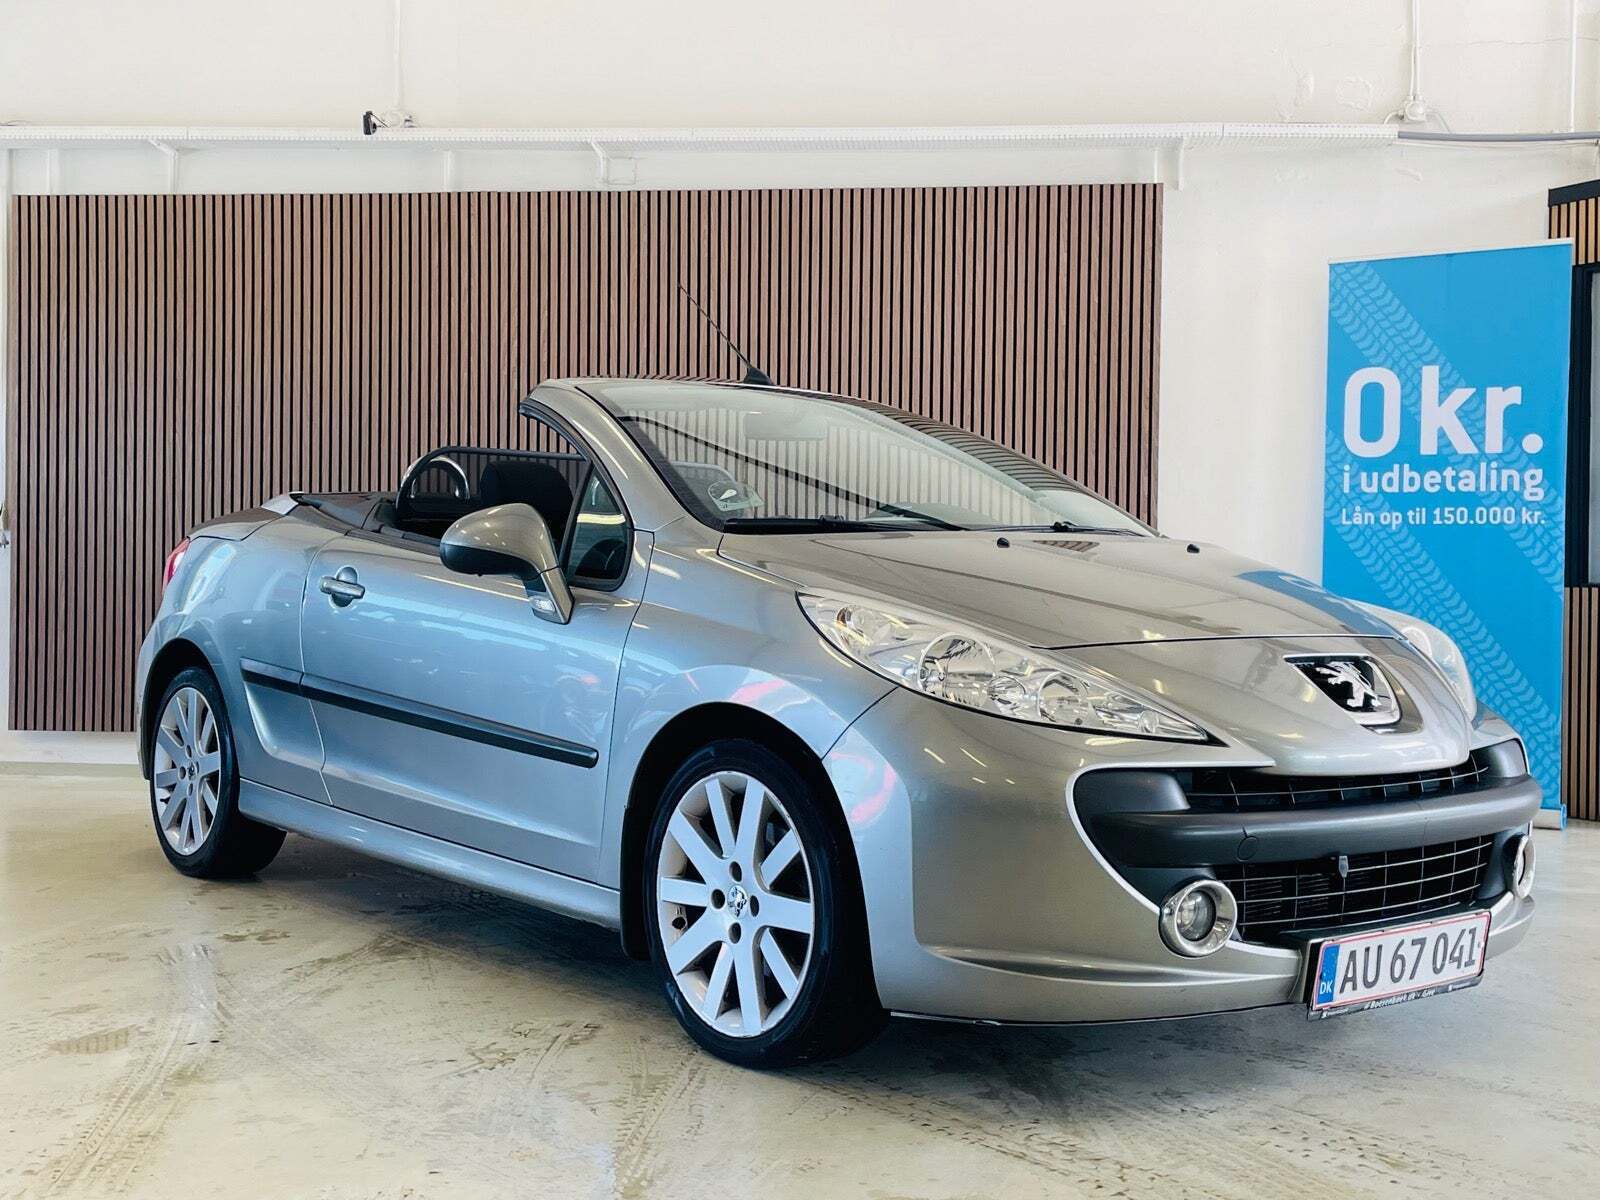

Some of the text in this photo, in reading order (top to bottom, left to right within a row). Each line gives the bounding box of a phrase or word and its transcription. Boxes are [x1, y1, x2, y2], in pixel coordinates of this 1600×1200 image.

[1344, 365, 1544, 457] 0 kr.
[1343, 461, 1545, 502] i udbetaling
[1341, 506, 1546, 529] Lån op til 150.000 kr.
[1339, 927, 1478, 994] AU 67 041
[1319, 981, 1333, 995] DK
